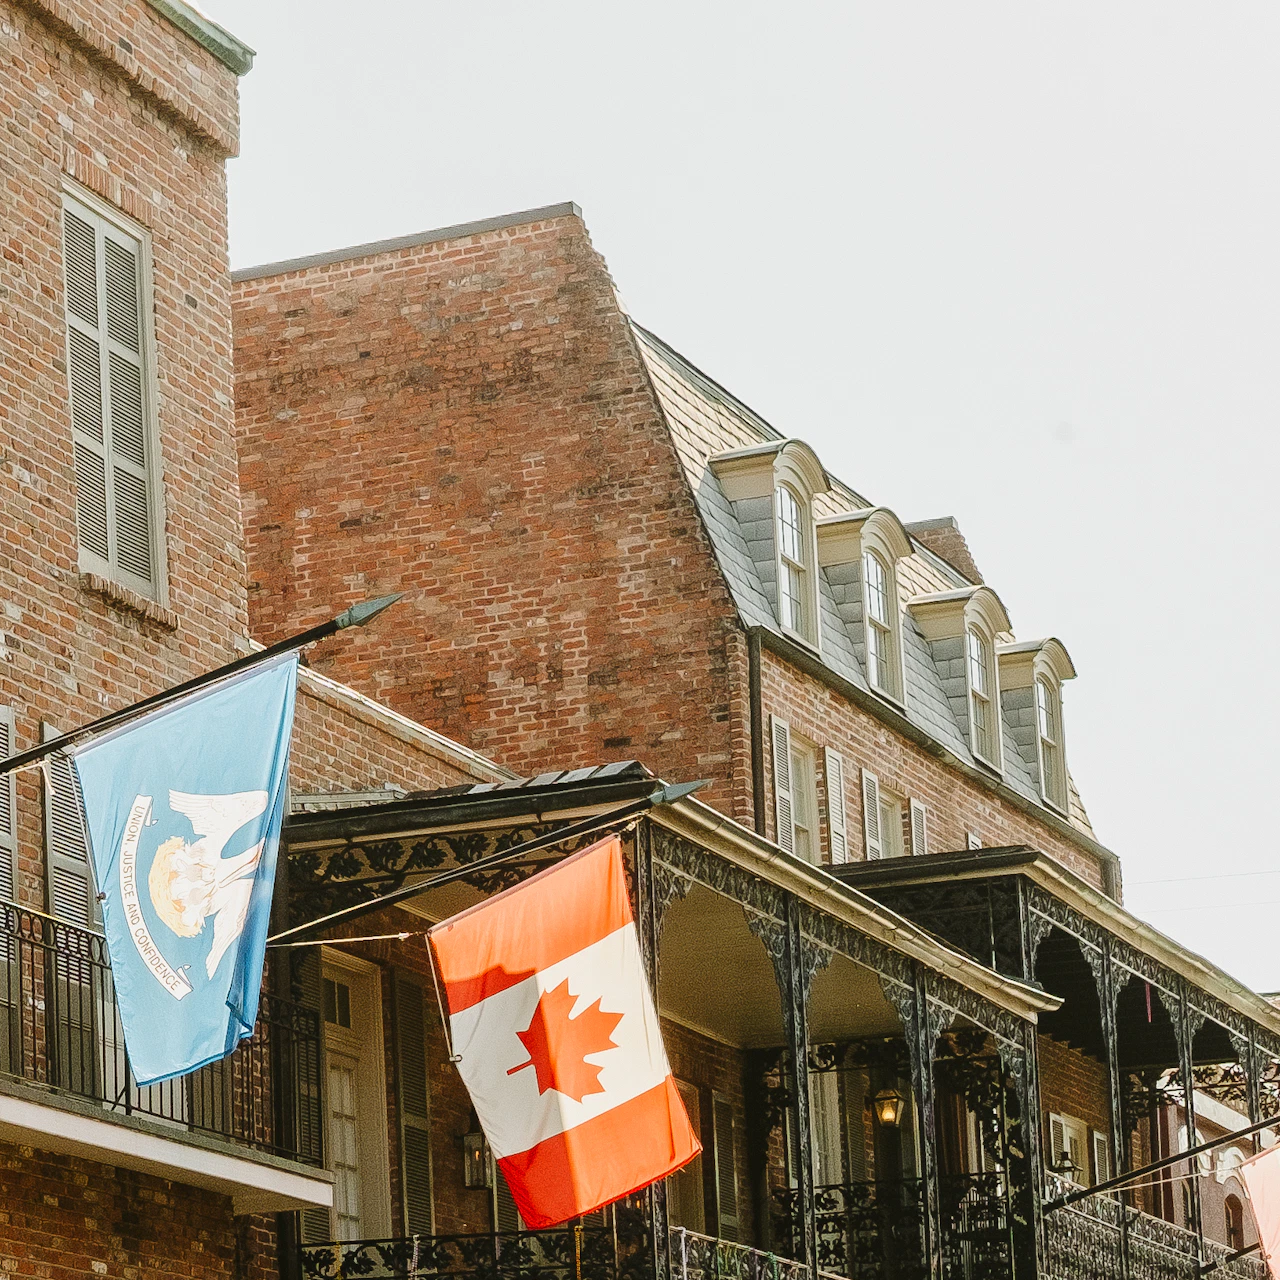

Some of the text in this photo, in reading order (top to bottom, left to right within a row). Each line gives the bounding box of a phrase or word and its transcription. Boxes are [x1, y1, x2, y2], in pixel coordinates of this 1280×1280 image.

[122, 850, 135, 899] JUSTICE
[127, 902, 140, 926] AND
[134, 927, 181, 992] CONFIDENCE
